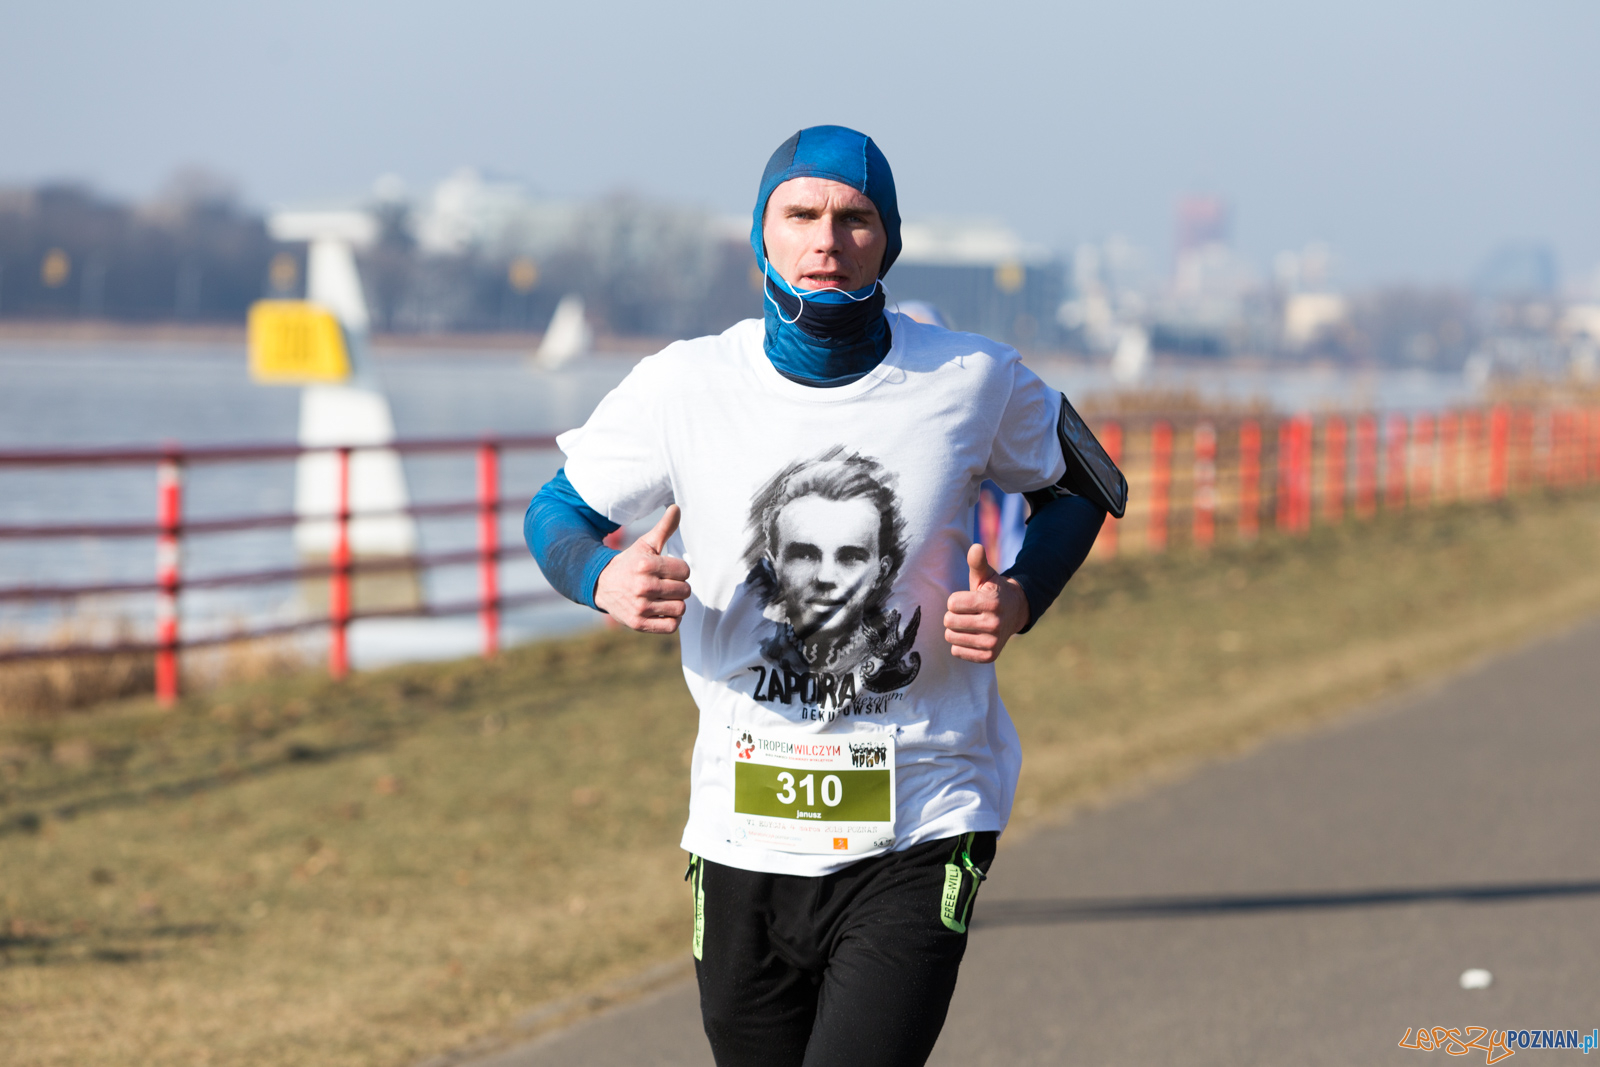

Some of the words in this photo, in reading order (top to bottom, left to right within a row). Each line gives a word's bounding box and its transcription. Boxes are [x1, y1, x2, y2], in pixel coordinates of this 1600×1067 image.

[747, 665, 857, 710] ZAPORA
[801, 701, 887, 722] DEKUOWSKI
[776, 771, 843, 807] 310
[796, 809, 822, 819] janusz
[943, 867, 959, 920] FREE-WILL
